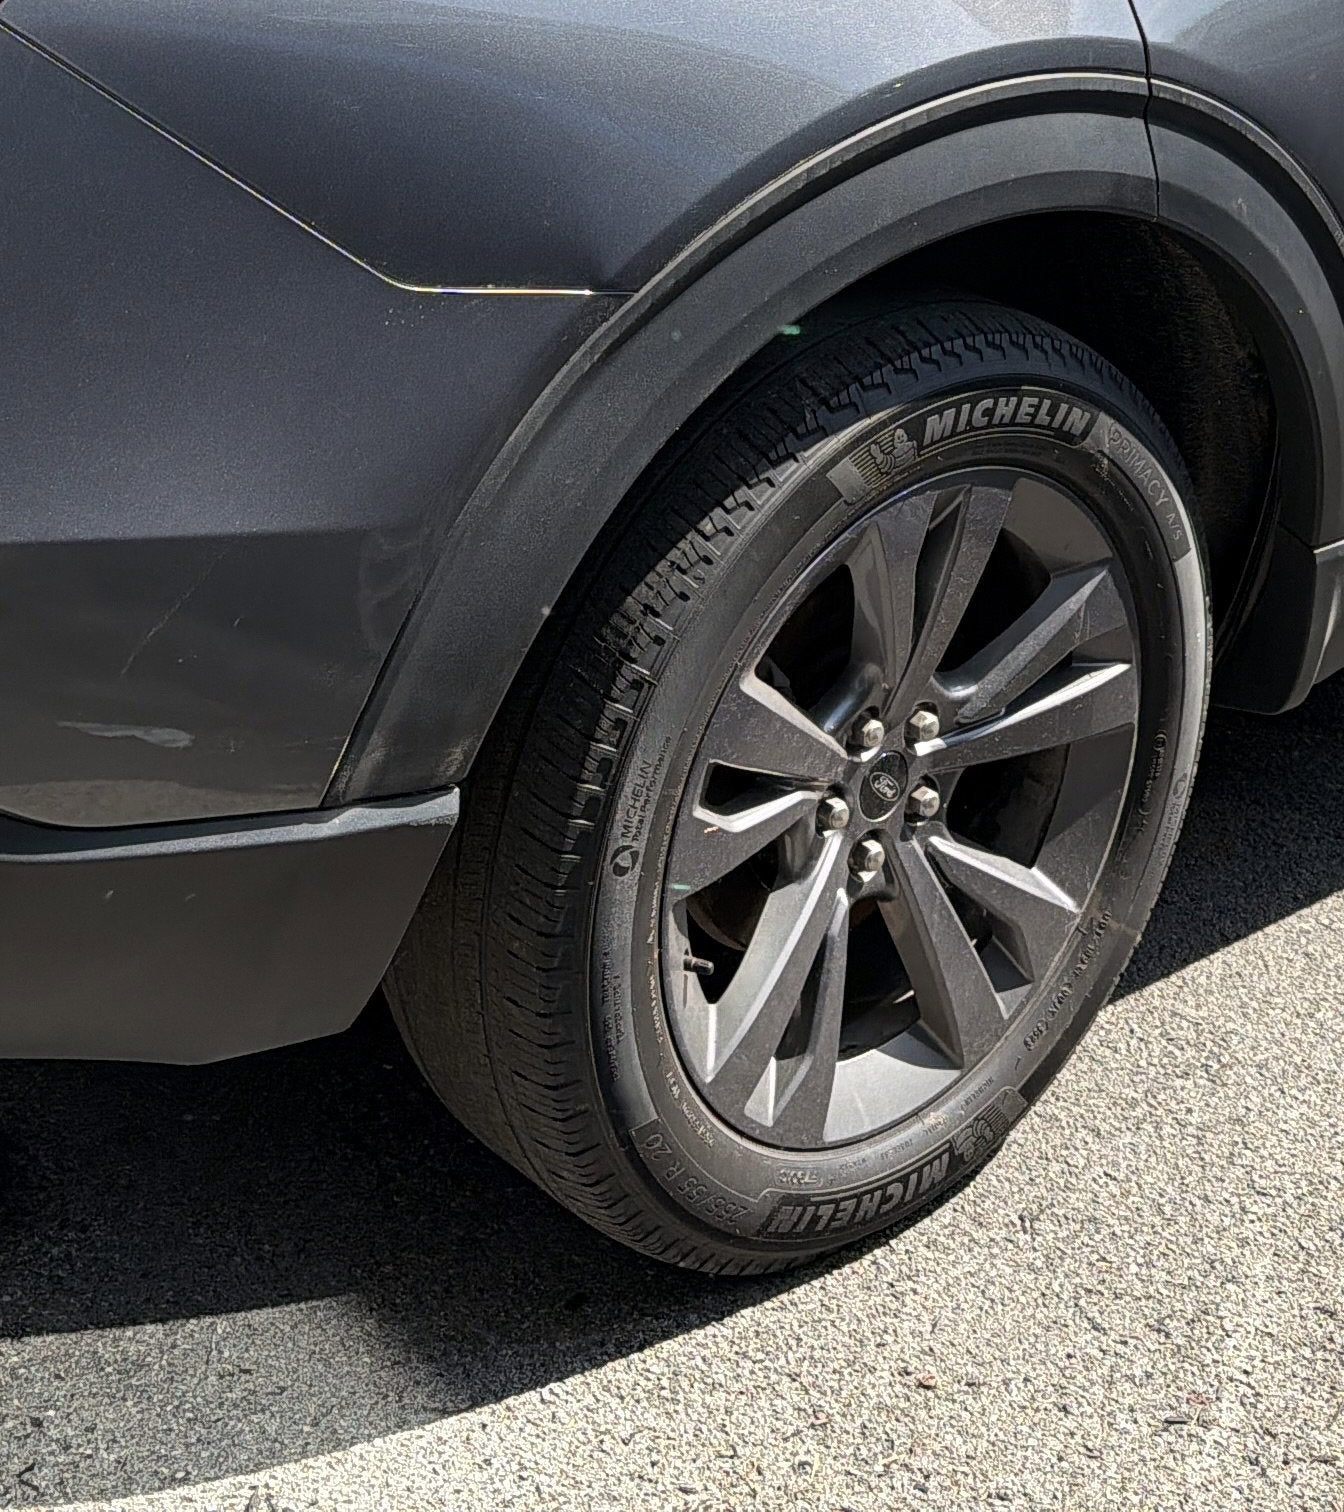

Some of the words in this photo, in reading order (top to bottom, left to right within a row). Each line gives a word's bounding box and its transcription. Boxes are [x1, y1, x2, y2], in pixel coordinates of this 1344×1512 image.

[923, 397, 1091, 446] MICHELIN
[1109, 428, 1168, 507] PRIMACY
[621, 760, 652, 839] MICHELIN
[644, 1132, 673, 1161] 20
[665, 1160, 686, 1182] R
[766, 1150, 951, 1234] MICHELIN
